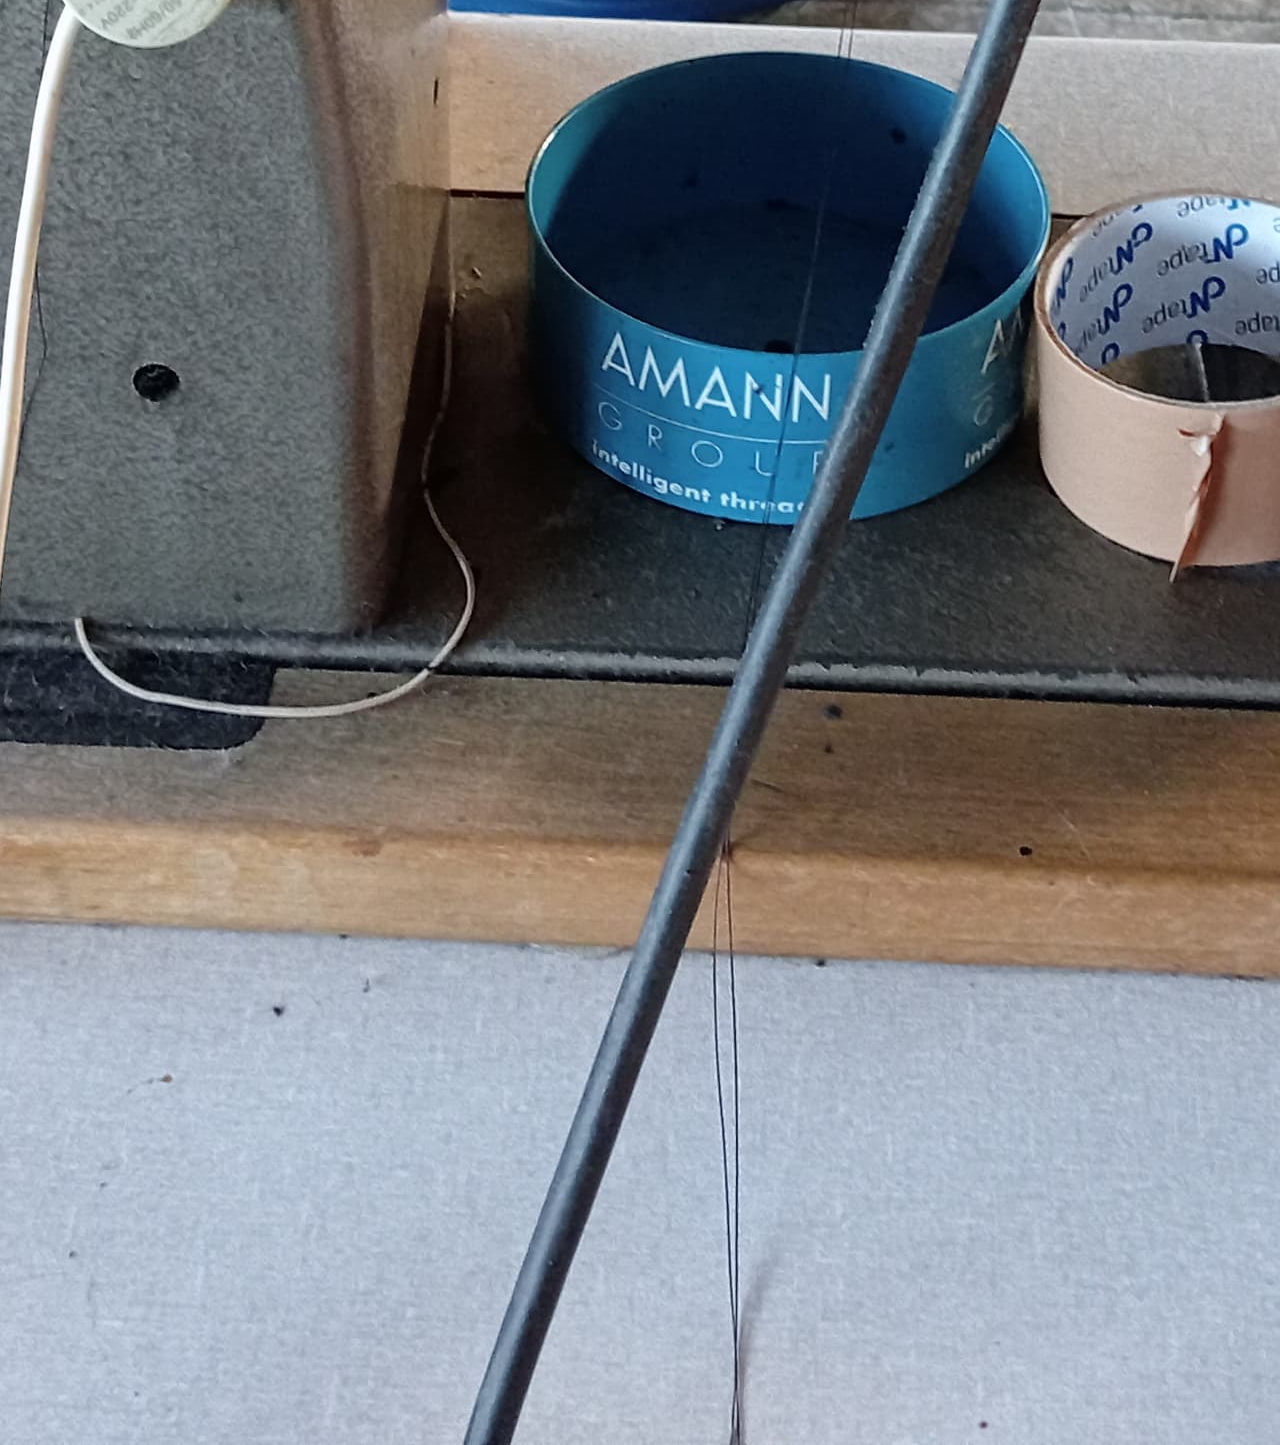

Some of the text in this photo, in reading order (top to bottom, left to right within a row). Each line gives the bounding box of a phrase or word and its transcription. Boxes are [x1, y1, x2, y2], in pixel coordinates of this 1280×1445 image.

[601, 332, 831, 423] AMANN
[592, 440, 805, 513] intelligent threa
